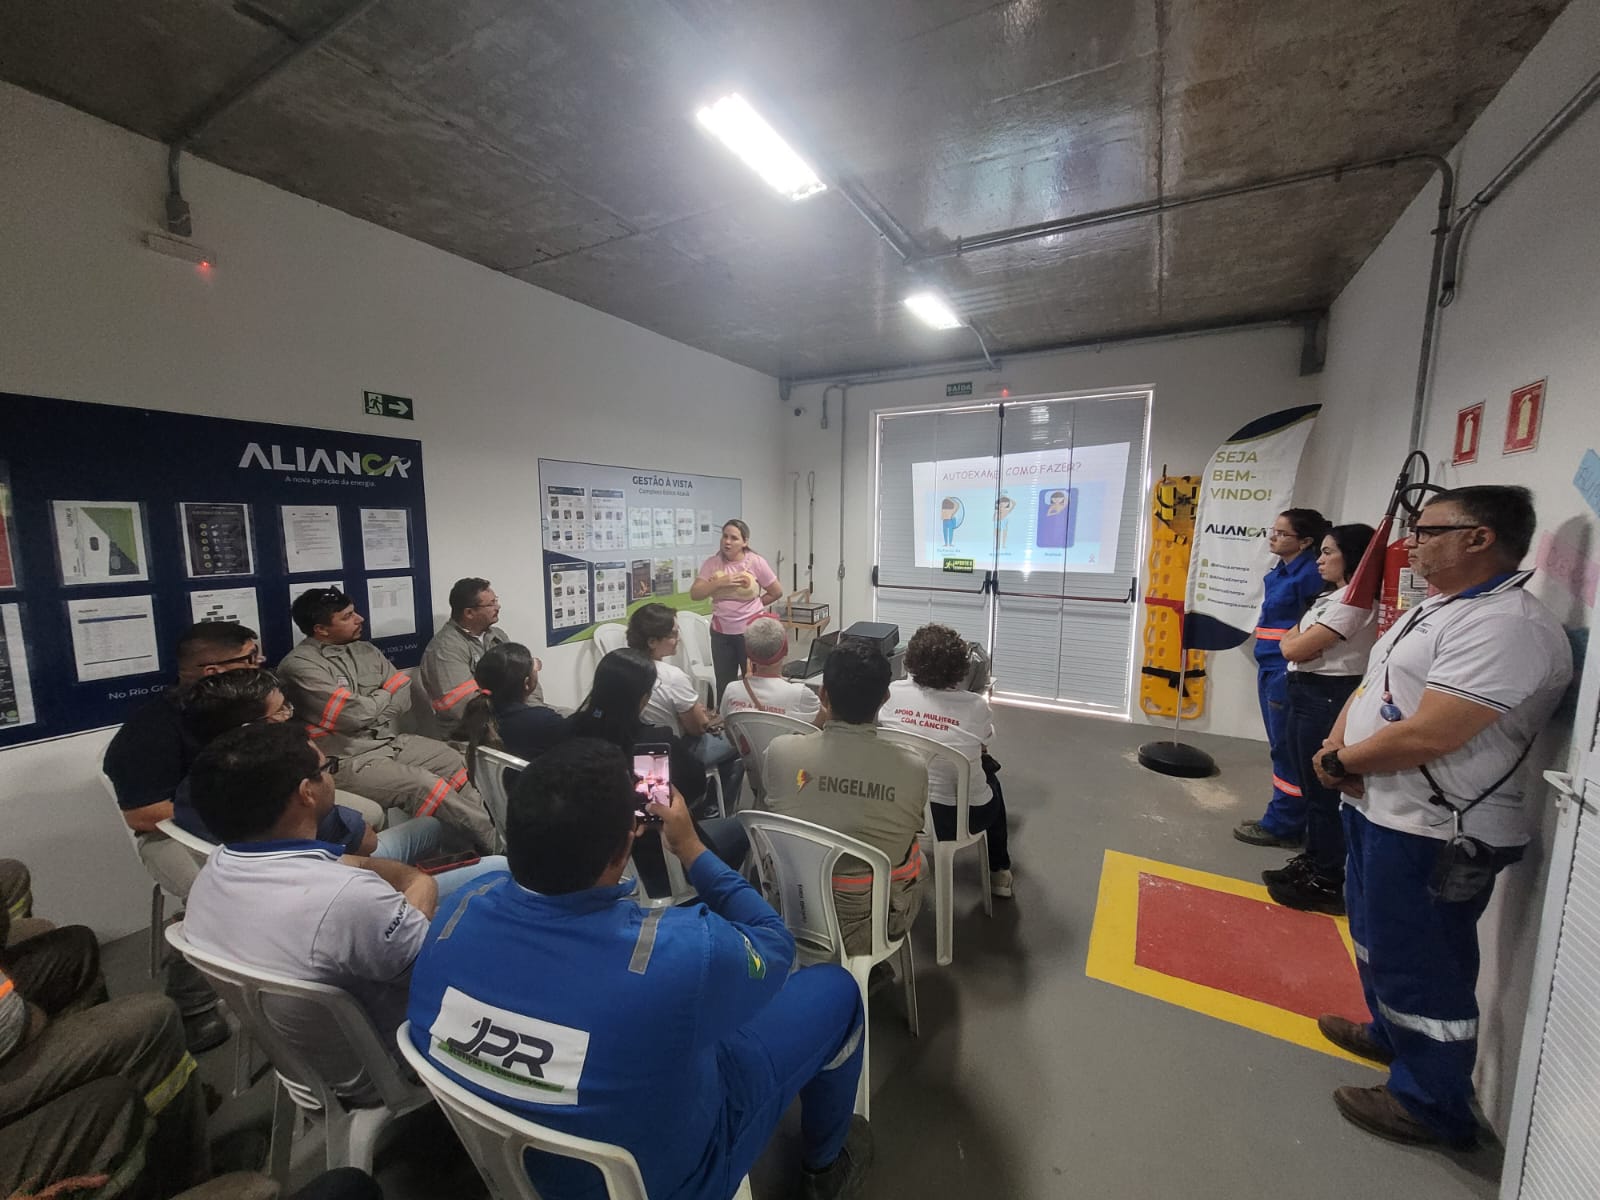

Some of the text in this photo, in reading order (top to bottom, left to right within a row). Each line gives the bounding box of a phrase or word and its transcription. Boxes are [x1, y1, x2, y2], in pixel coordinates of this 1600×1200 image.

[1215, 451, 1258, 463] SEJA
[1006, 464, 1038, 477] COMO
[1212, 470, 1257, 482] BEM-
[632, 474, 664, 487] GESTÃO
[672, 479, 693, 489] VISTA
[1211, 488, 1272, 501] VINDO!
[109, 691, 126, 700] No
[129, 687, 149, 696] Rio
[895, 708, 961, 727] APOIO A MULHERES
[901, 717, 949, 732] COM CÂNCER
[818, 775, 896, 802] ENGELMIG
[446, 1016, 554, 1079] JPR
